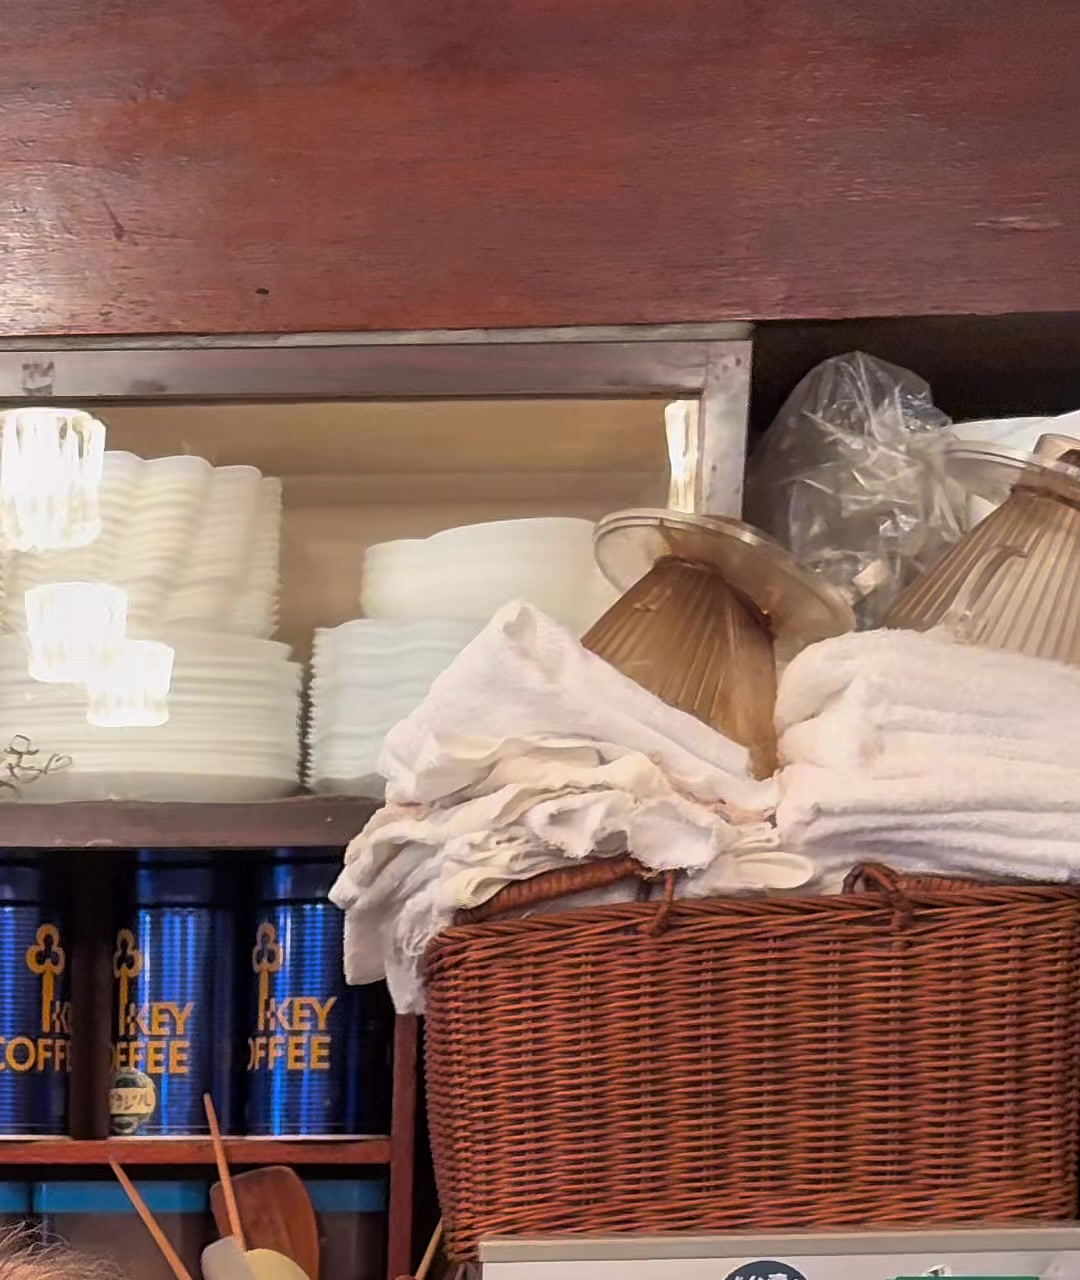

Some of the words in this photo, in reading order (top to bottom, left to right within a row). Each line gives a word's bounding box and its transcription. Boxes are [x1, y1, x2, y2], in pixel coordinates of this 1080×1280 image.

[126, 1001, 195, 1036] KEY
[266, 996, 338, 1031] KEY
[110, 1040, 191, 1073] FFEE
[247, 1035, 332, 1071] FFEE
